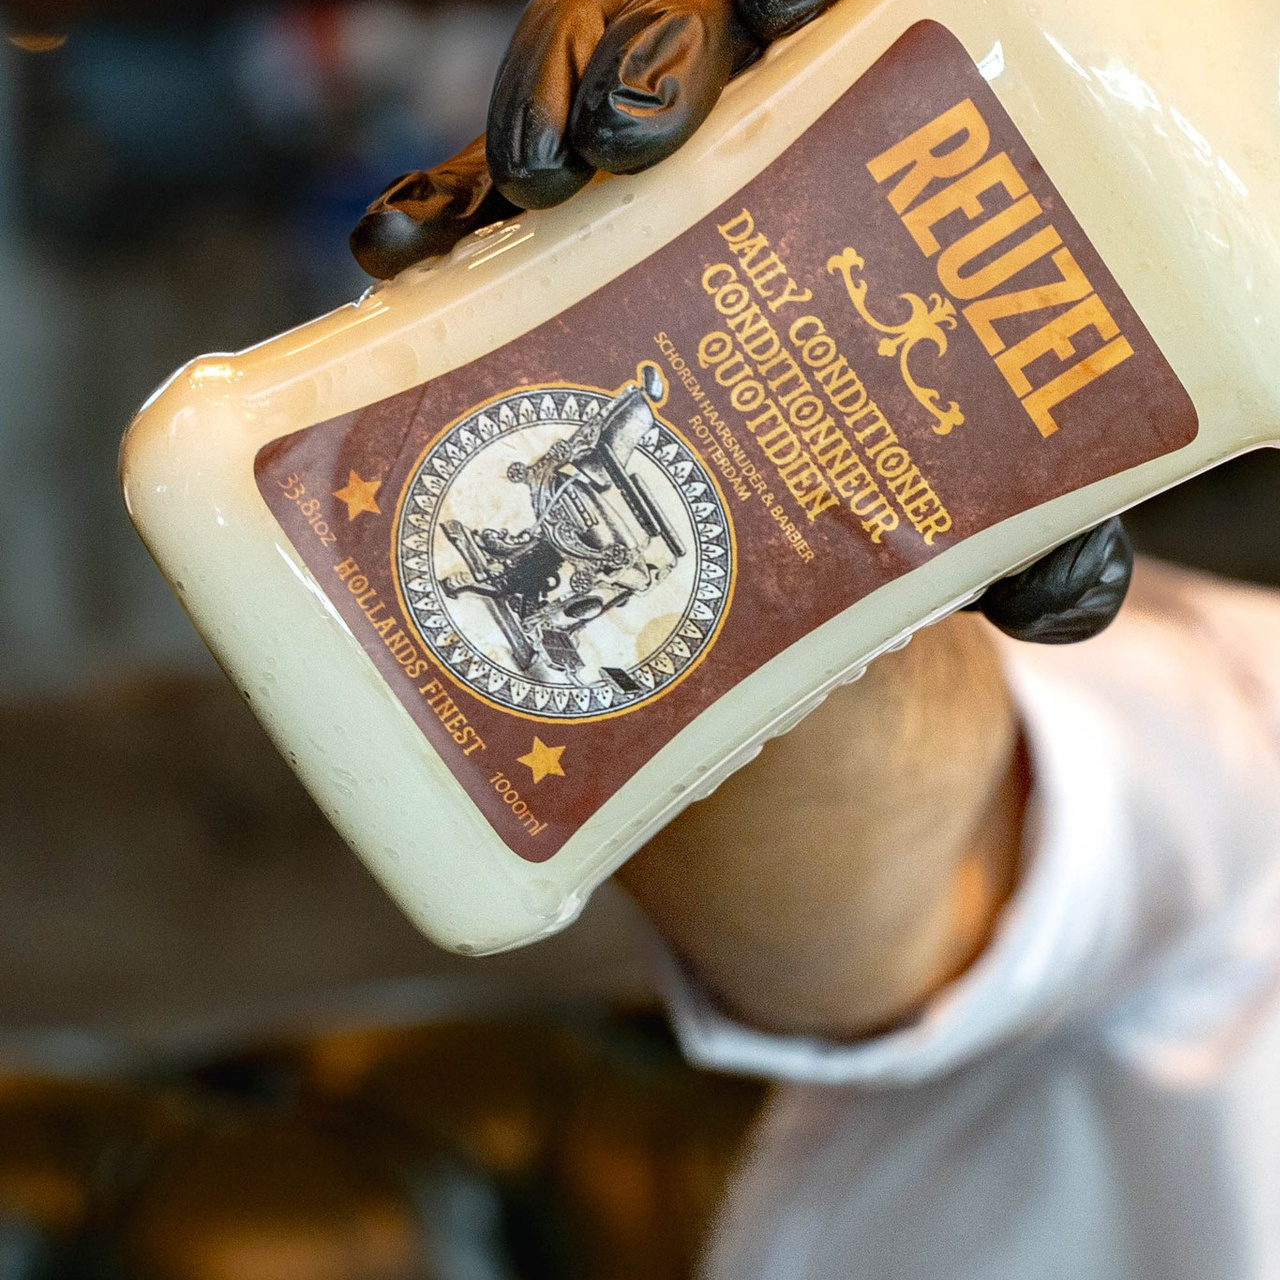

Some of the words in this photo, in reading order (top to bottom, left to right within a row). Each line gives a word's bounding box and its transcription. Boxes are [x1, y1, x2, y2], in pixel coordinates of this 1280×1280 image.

[716, 207, 813, 313] DAILY
[788, 314, 952, 546] CONDITIONER
[866, 97, 1135, 439] REUZEL
[653, 330, 706, 402] SCHOREM
[761, 490, 775, 505] &
[769, 503, 816, 564] BARBIER
[688, 415, 752, 502] ROTTERDAM
[697, 330, 841, 522] QUOTIDIEN
[701, 262, 900, 545] CONDITIONNEUR
[333, 555, 429, 681] HOLLANDS
[419, 677, 486, 756] FINEST
[489, 771, 549, 838] 1000ml
